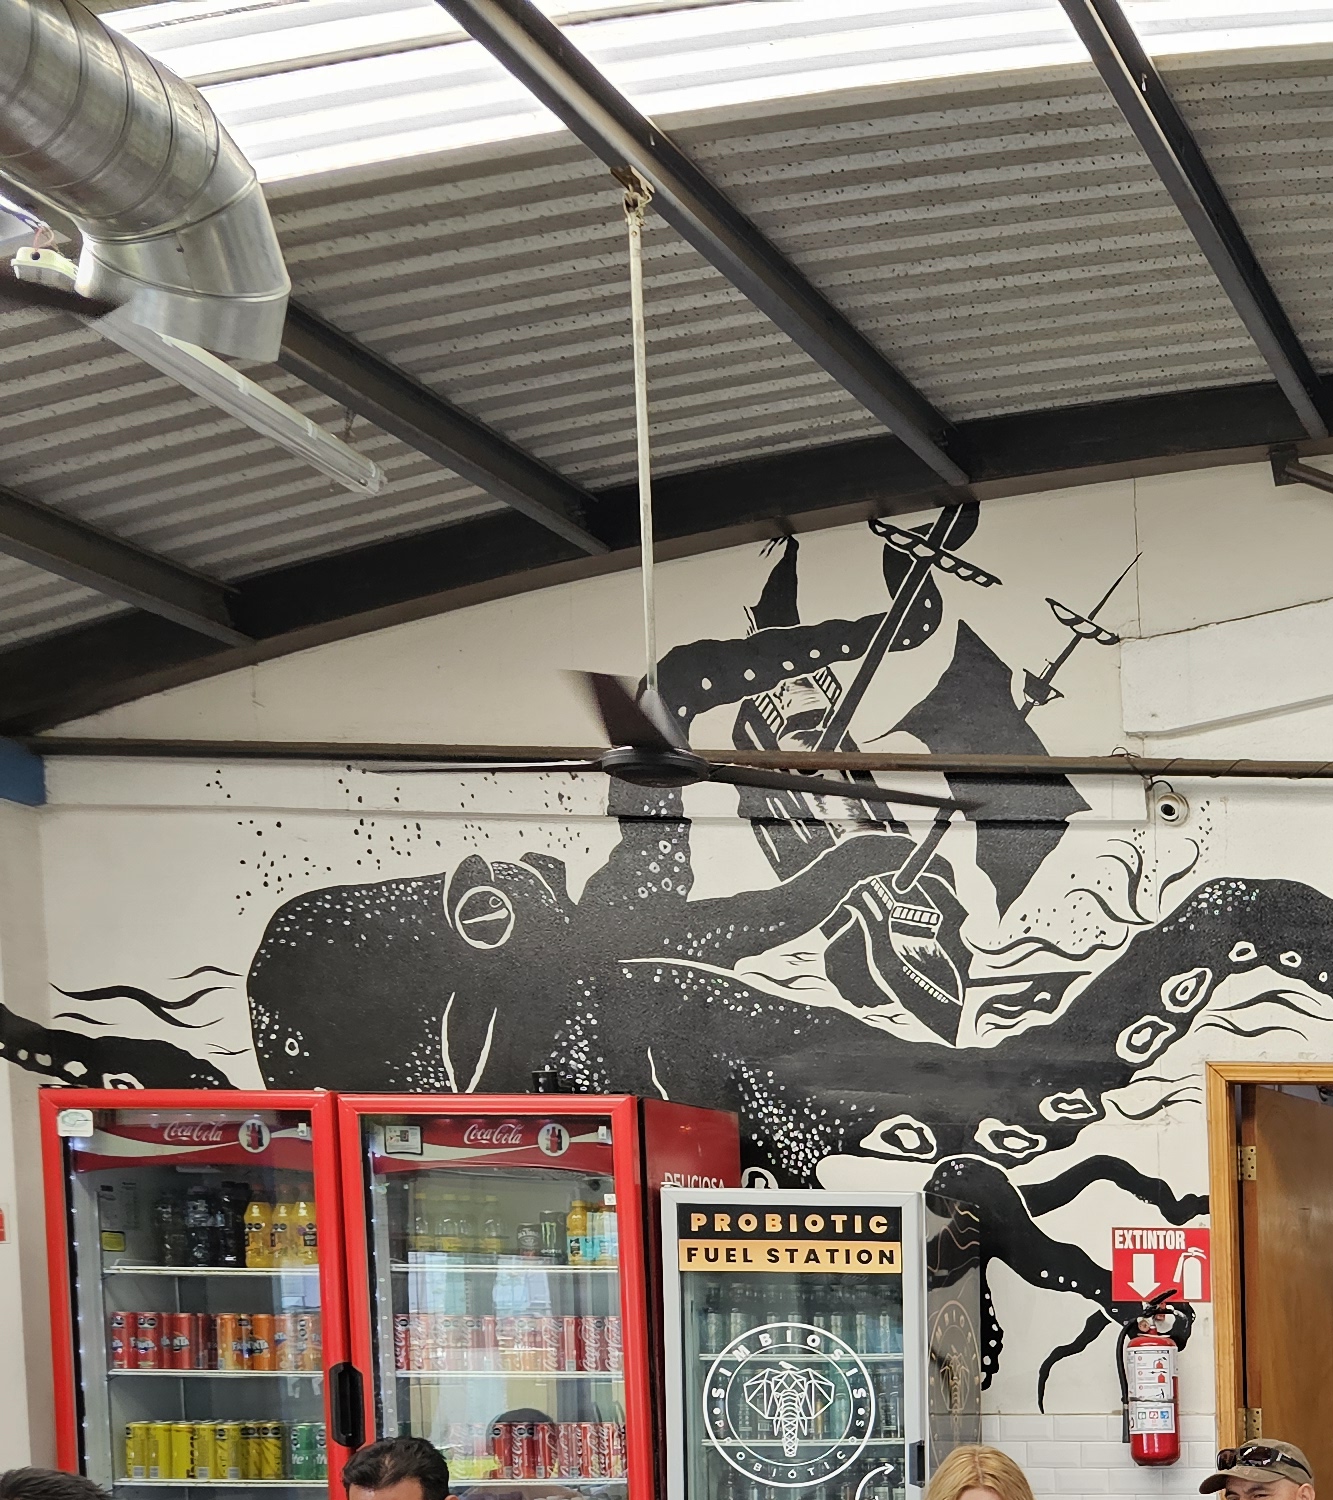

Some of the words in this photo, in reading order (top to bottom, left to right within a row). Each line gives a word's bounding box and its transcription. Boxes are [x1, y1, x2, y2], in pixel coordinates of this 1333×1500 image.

[690, 1212, 889, 1234] PROBIOTIC
[1114, 1229, 1186, 1250] EXTINTOR
[686, 1247, 753, 1264] FUEL
[766, 1247, 895, 1265] STATION
[711, 1329, 868, 1400] SIMBIOSIS
